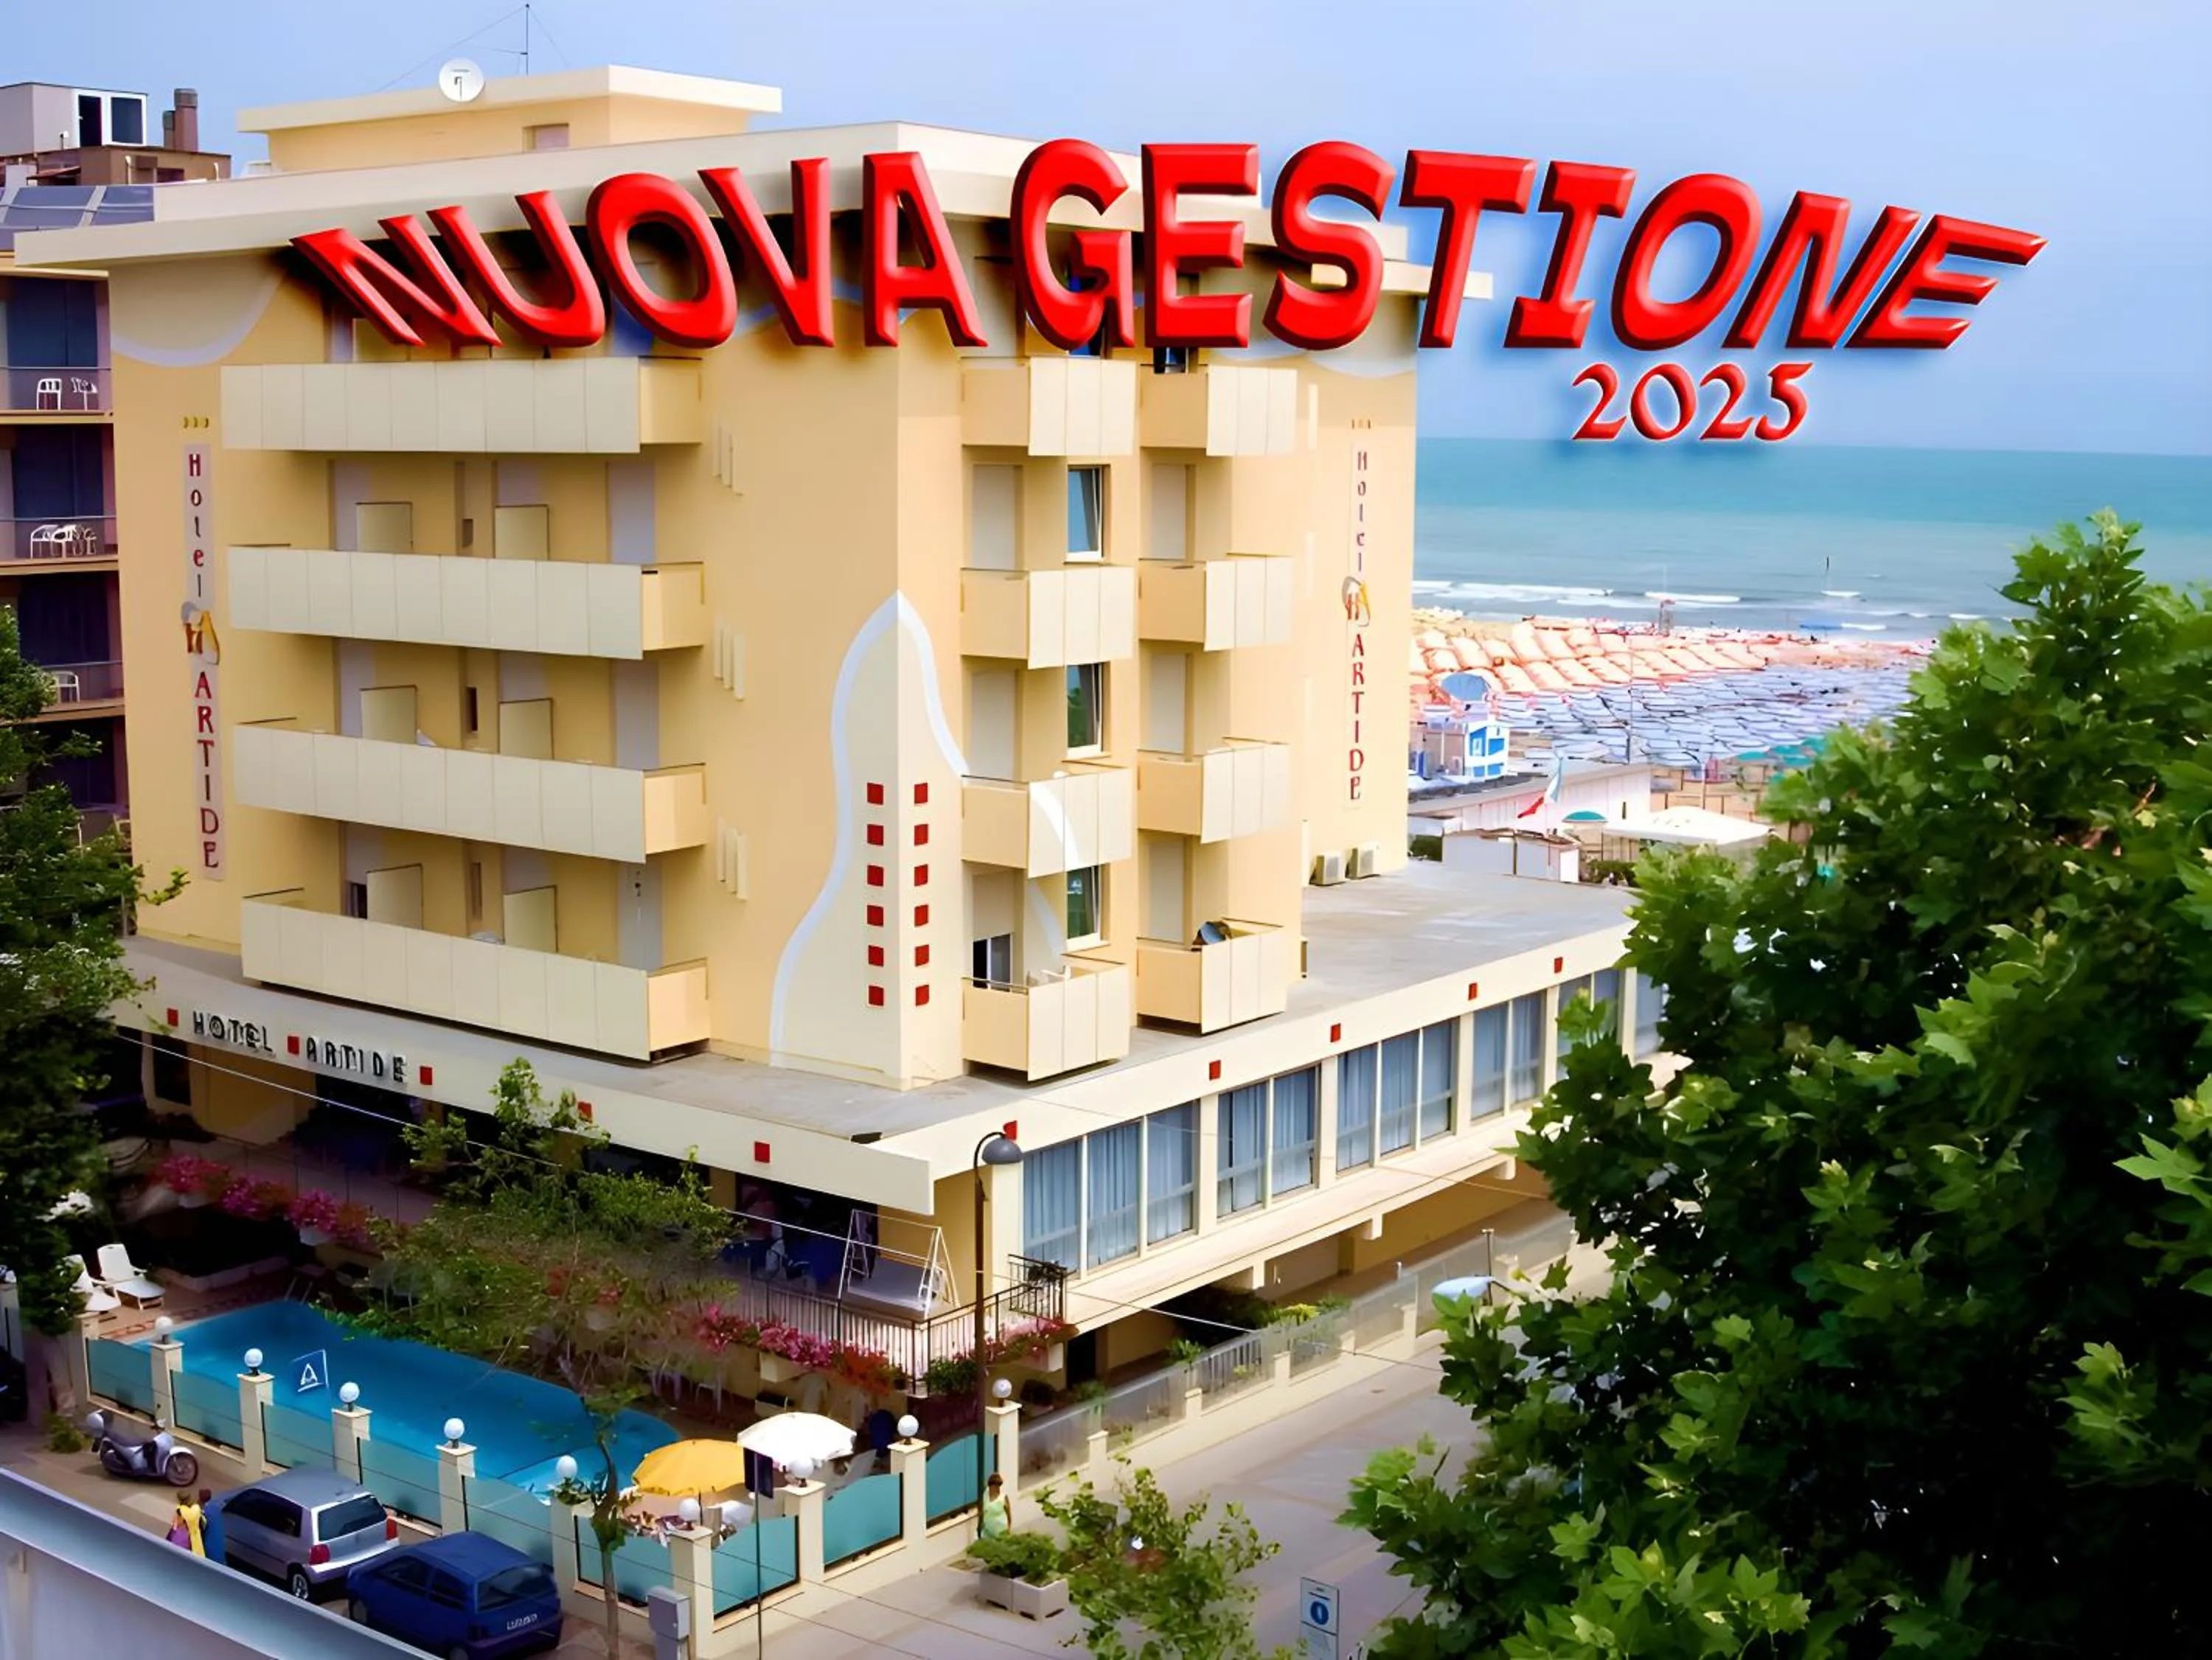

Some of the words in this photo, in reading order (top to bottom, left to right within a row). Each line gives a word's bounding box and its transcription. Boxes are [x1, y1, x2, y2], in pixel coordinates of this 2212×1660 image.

[194, 671, 220, 870] ARTIDE
[1349, 633, 1366, 801] ARTIDE
[192, 1010, 275, 1053] HOTEL
[305, 1036, 408, 1084] ARTIDE
